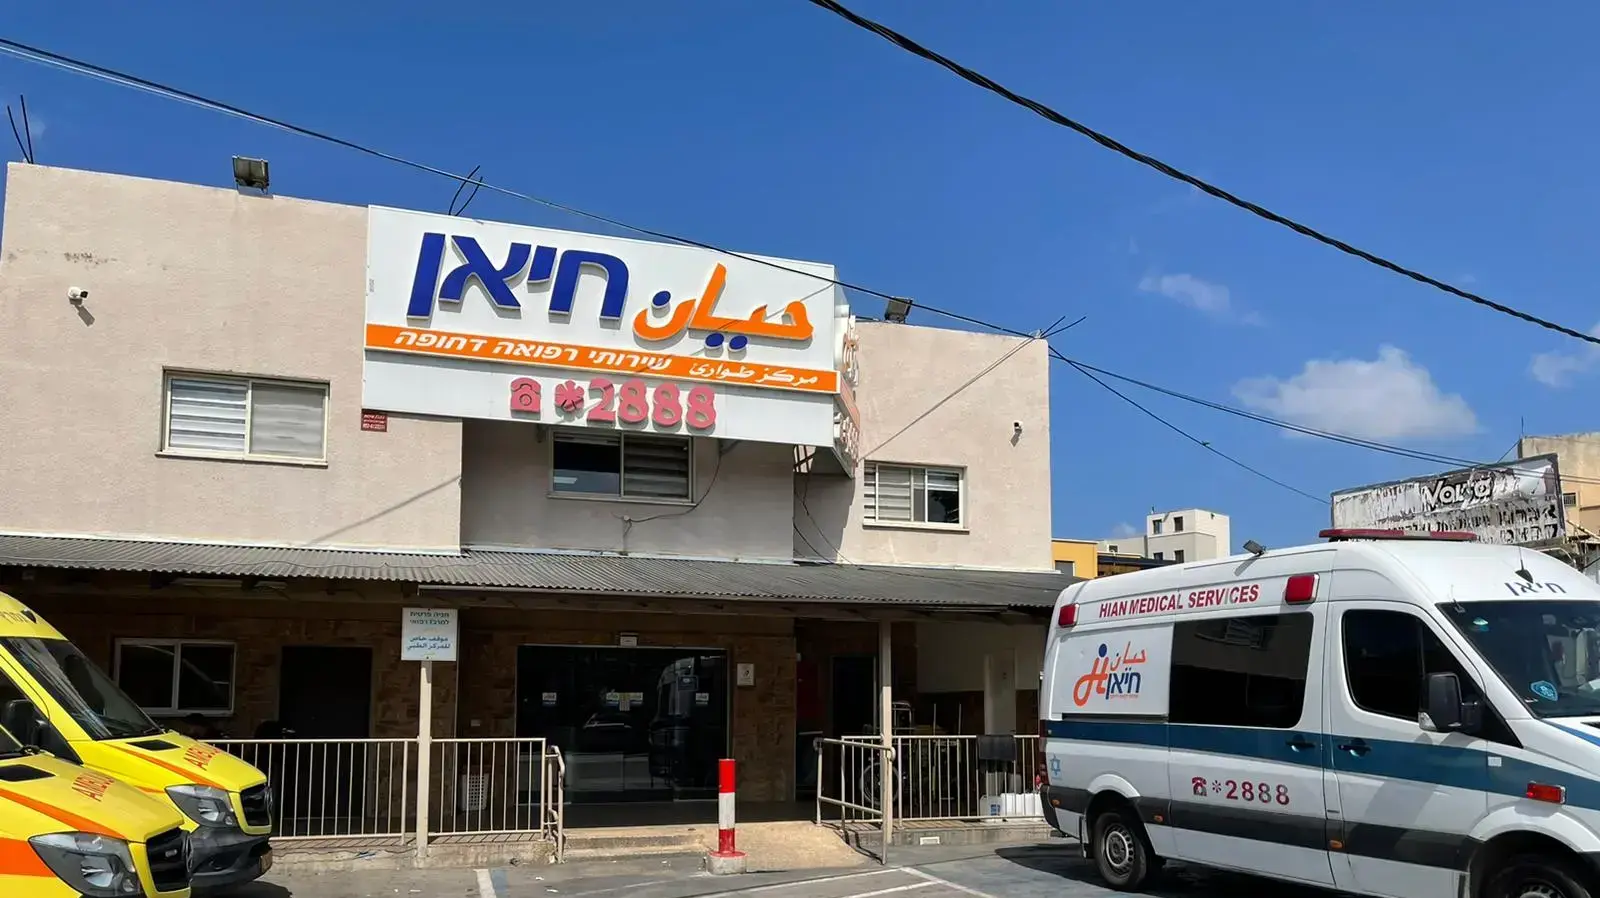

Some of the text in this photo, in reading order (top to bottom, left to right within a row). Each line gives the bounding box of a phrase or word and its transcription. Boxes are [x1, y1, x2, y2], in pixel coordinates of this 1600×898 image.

[407, 232, 629, 319] חיאן
[633, 263, 814, 352] حيان
[394, 331, 673, 371] שירותי רפואה דחופה
[755, 367, 818, 387] مركز
[1099, 584, 1260, 618] HIAN MEDICAL SERVICES
[1105, 672, 1141, 700] חיאן
